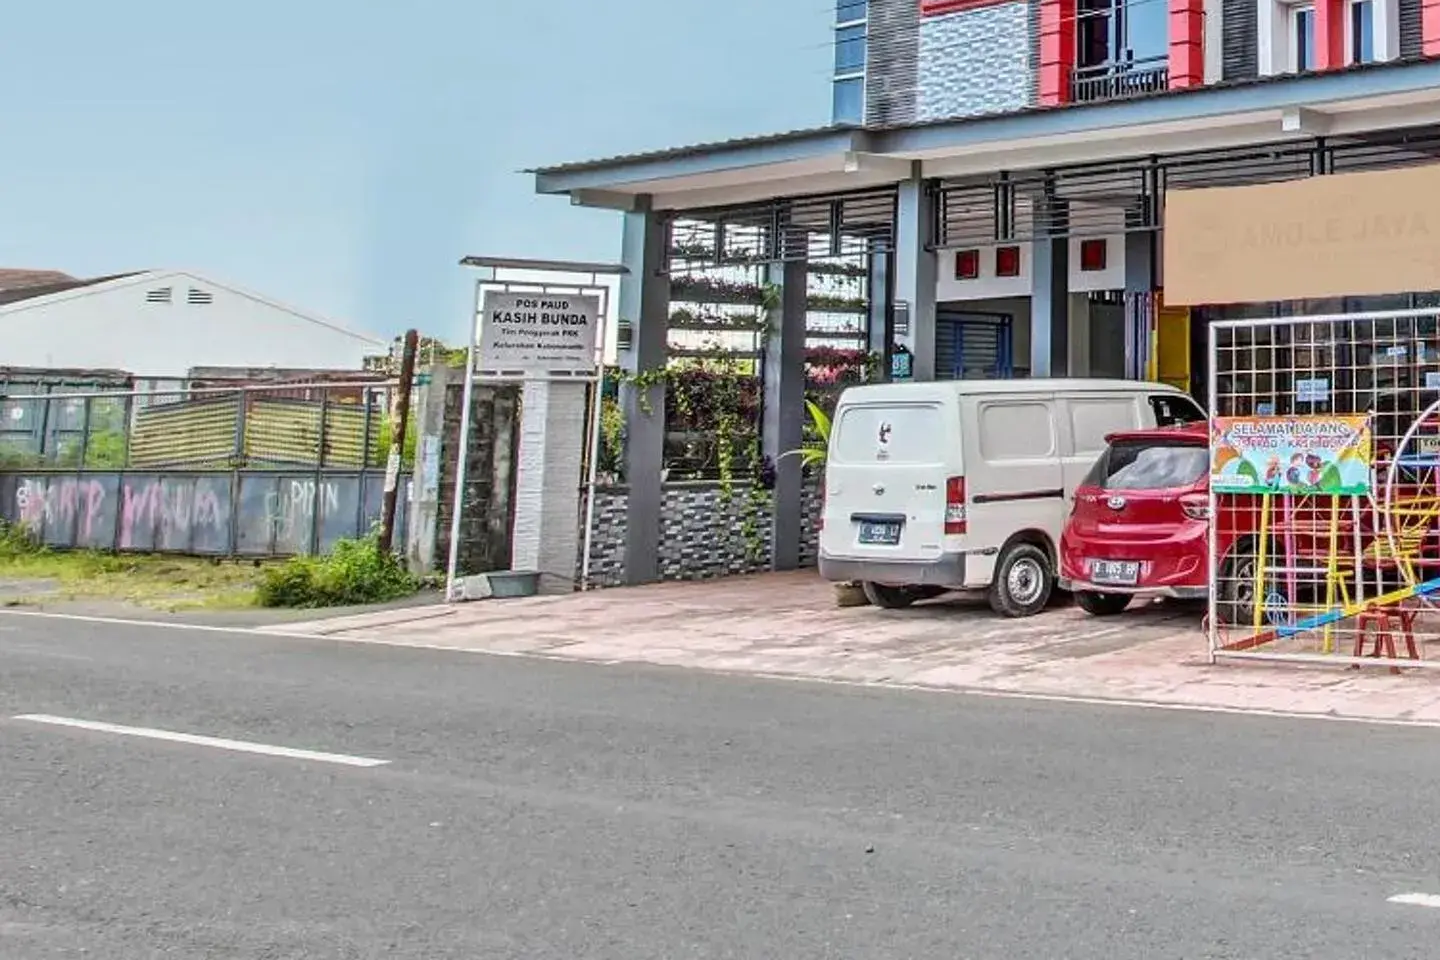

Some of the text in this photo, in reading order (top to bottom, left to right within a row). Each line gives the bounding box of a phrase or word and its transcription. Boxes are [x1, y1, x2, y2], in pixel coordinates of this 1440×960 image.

[516, 299, 569, 310] POS PAUD
[493, 311, 587, 325] KASIH BUNDA
